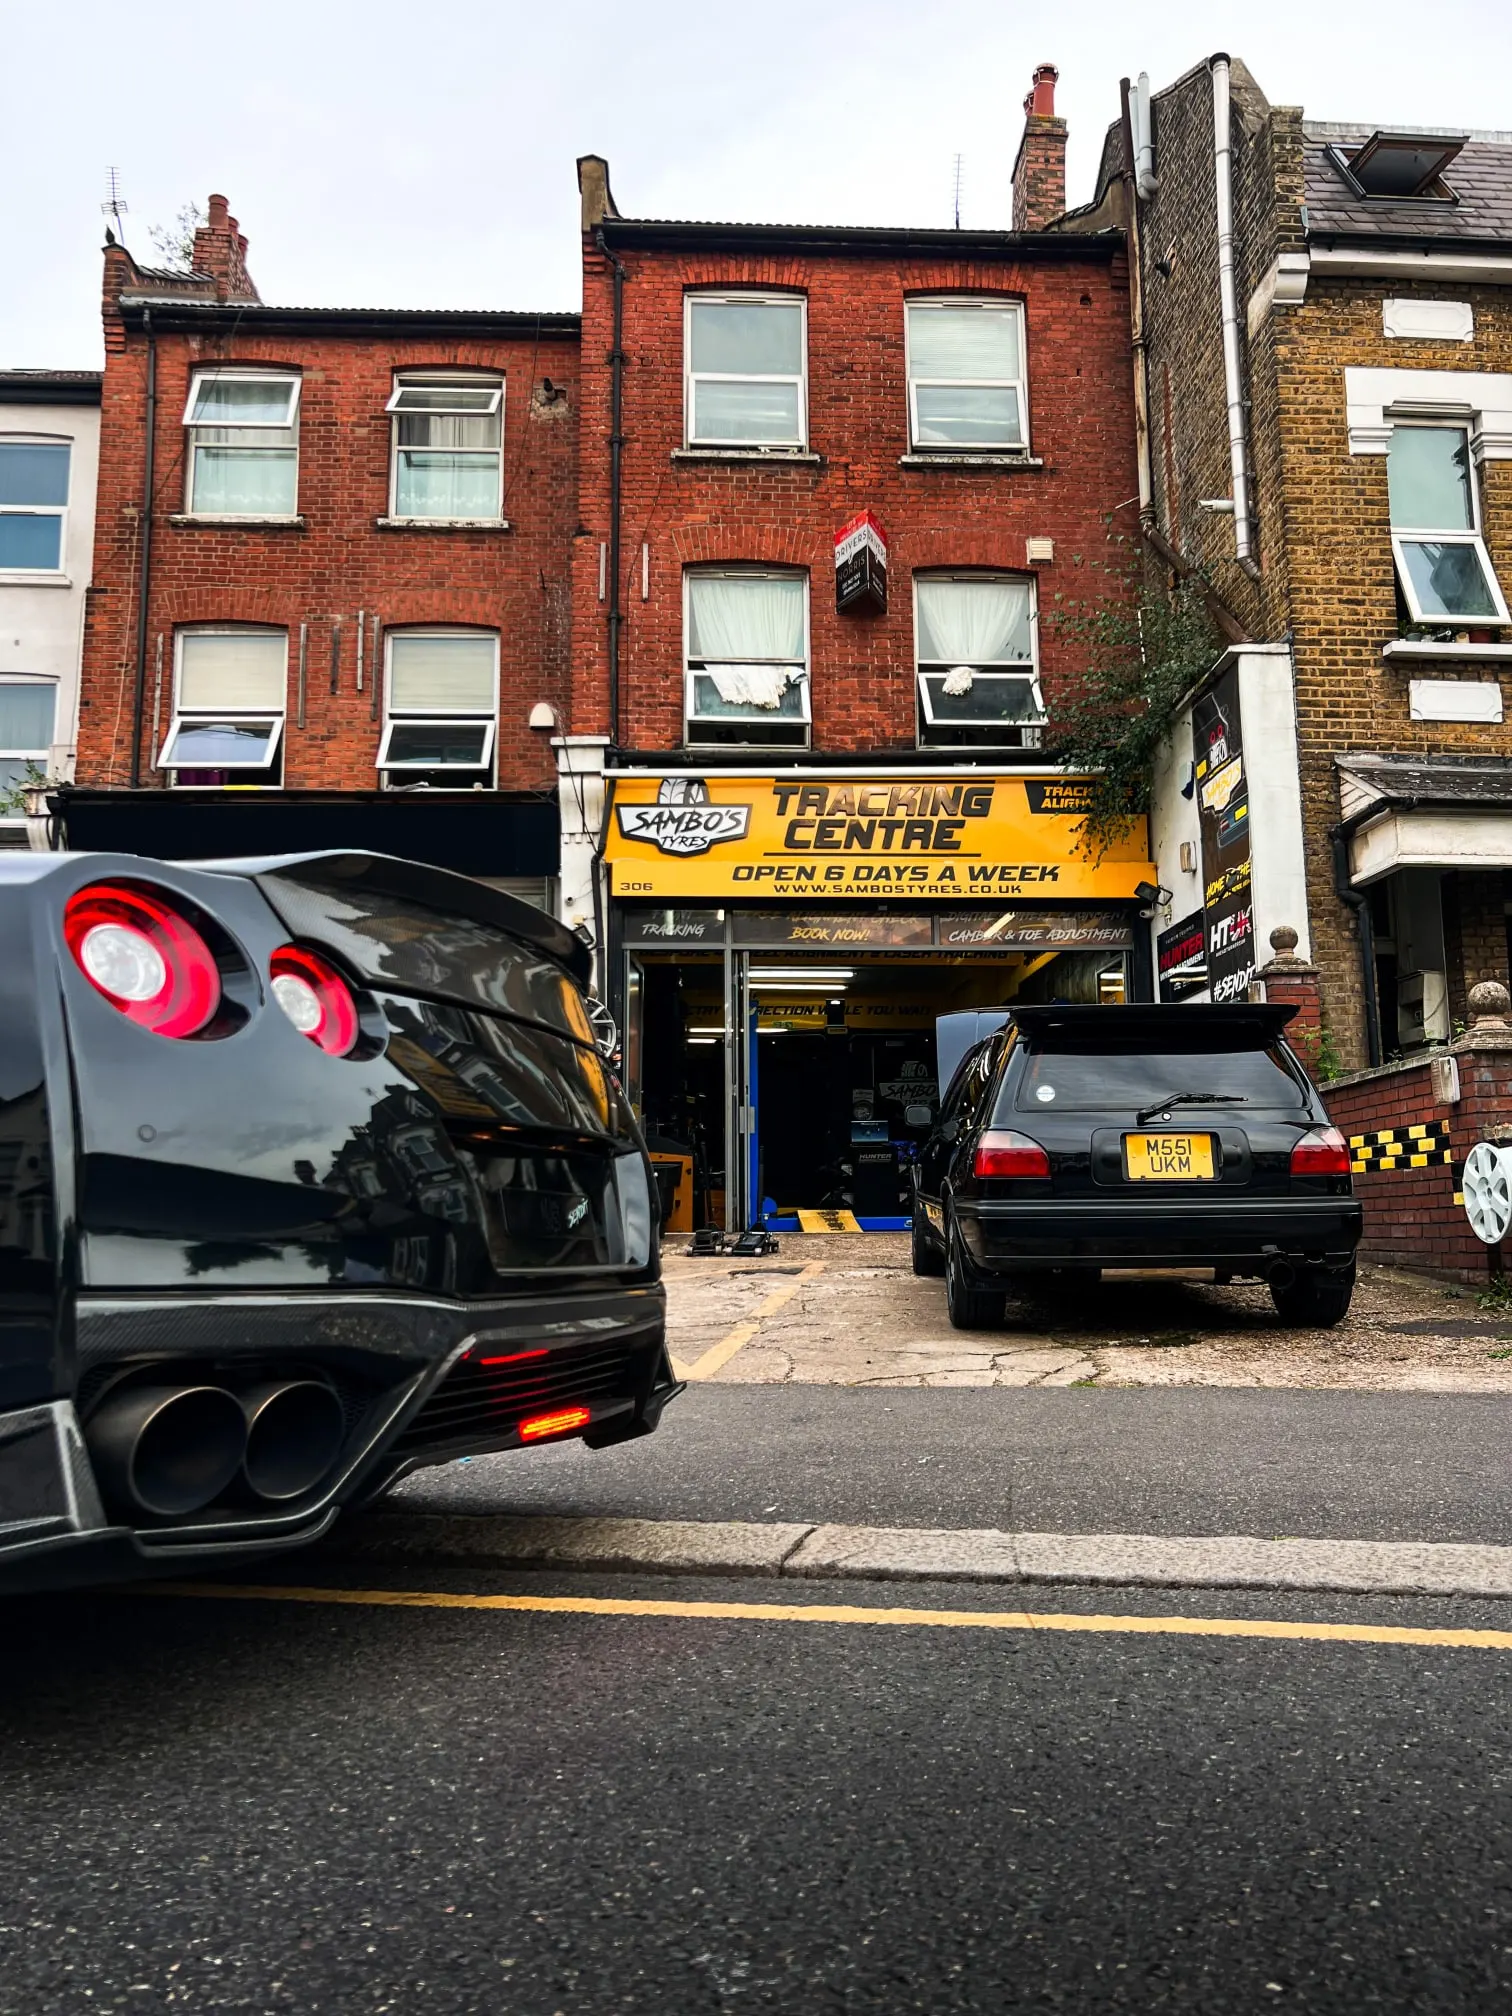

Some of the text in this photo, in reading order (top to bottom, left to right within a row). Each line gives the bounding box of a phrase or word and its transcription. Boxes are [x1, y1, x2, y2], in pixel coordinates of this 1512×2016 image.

[836, 530, 867, 561] DRIVERS
[773, 785, 994, 817] TRACKING
[625, 808, 742, 834] SAMBO'S
[784, 818, 966, 850] CENTRE
[661, 836, 708, 849] TYRES
[732, 865, 1060, 882] OPEN 6 DAYS A WEEK
[620, 882, 653, 891] 306
[774, 884, 1022, 894] WWW.SAMBOSTYRES.CO.UK
[641, 923, 705, 938] TRACKING
[786, 927, 871, 942] BOOK NOW!
[949, 928, 1129, 942] CAMBR & TOE ADJUSTMENT
[1160, 932, 1204, 972] HUNTER
[1146, 1139, 1192, 1155] M551
[1150, 1156, 1191, 1173] UKM
